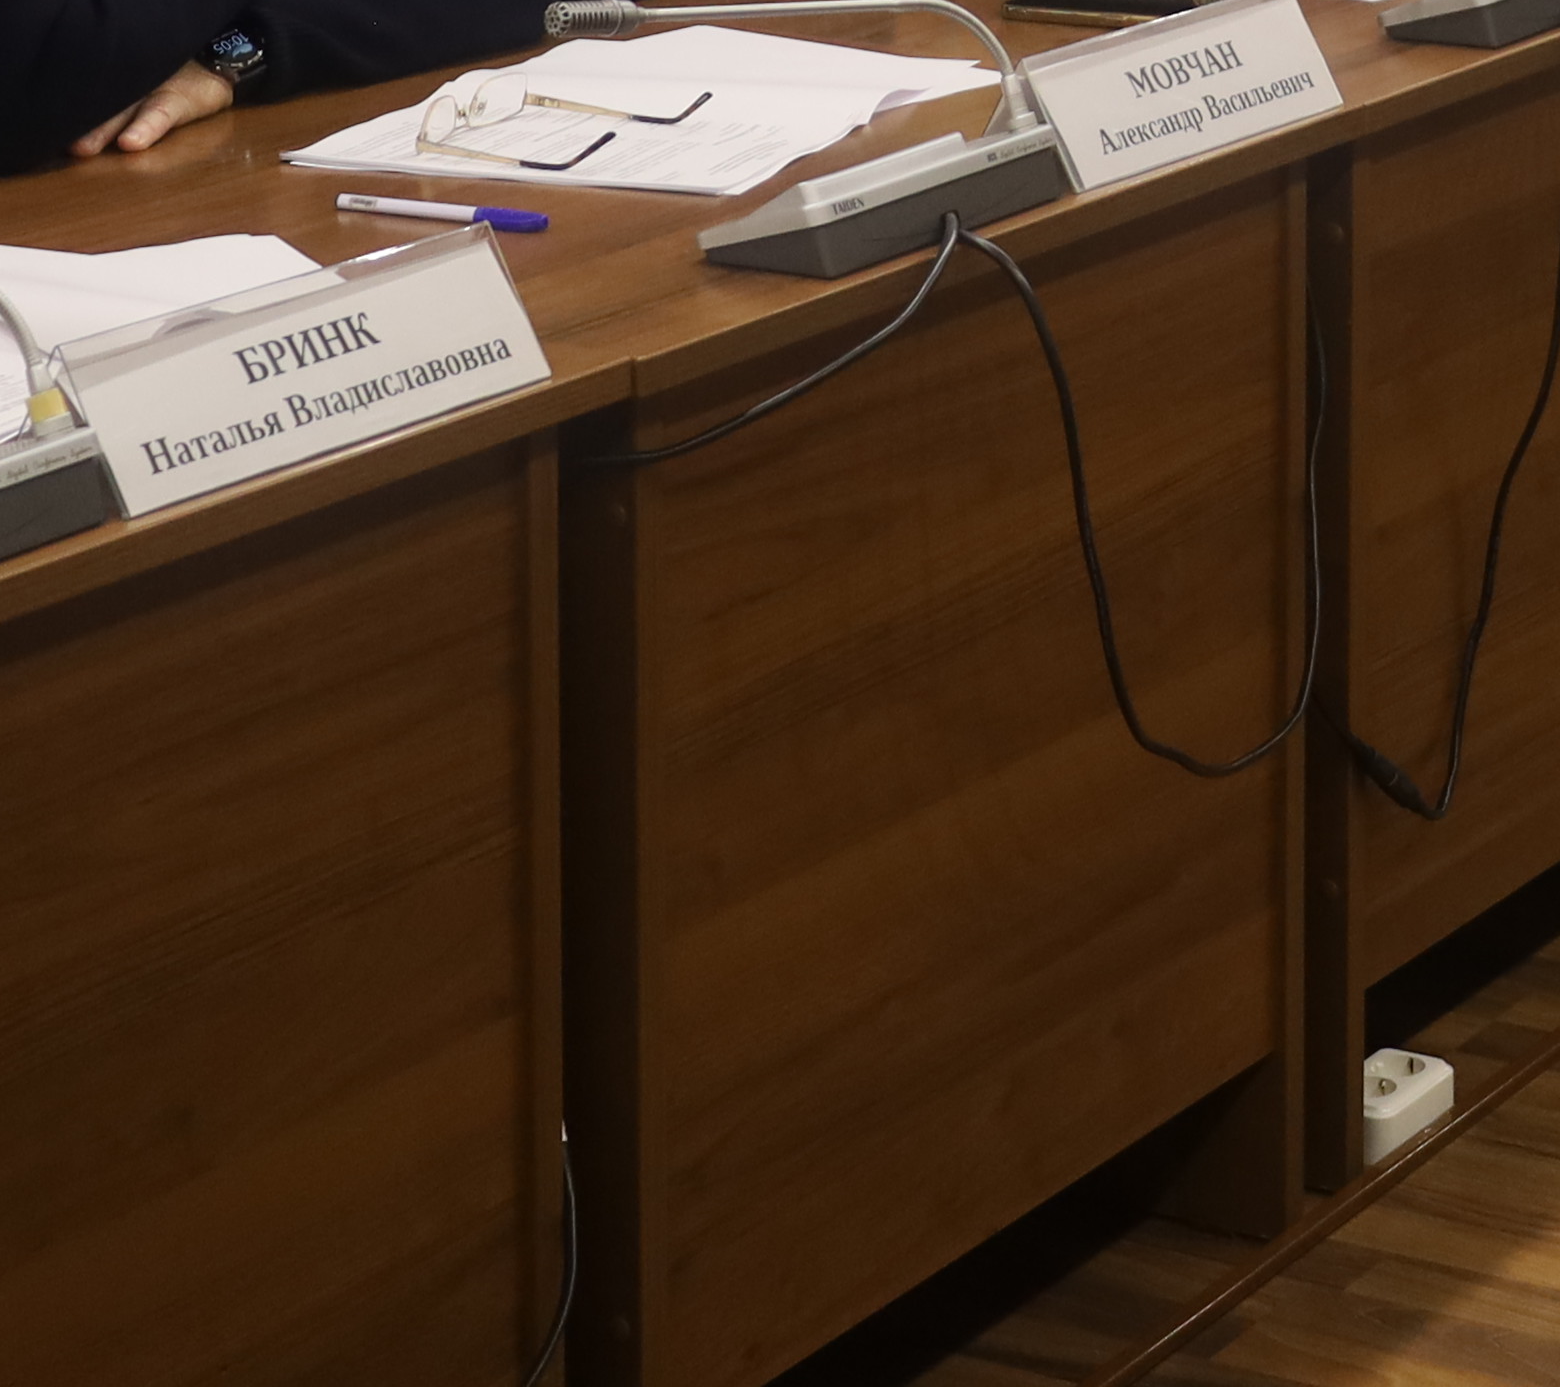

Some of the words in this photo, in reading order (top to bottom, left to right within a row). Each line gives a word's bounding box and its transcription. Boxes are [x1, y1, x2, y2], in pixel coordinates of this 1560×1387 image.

[212, 32, 249, 55] 10:05
[1124, 39, 1244, 99] МОВЧАН
[1098, 111, 1204, 156] Александр
[1202, 69, 1316, 121] Васильевич
[232, 311, 382, 385] БРИНК
[140, 413, 286, 476] Наталья
[283, 338, 513, 428] Владиславовна
